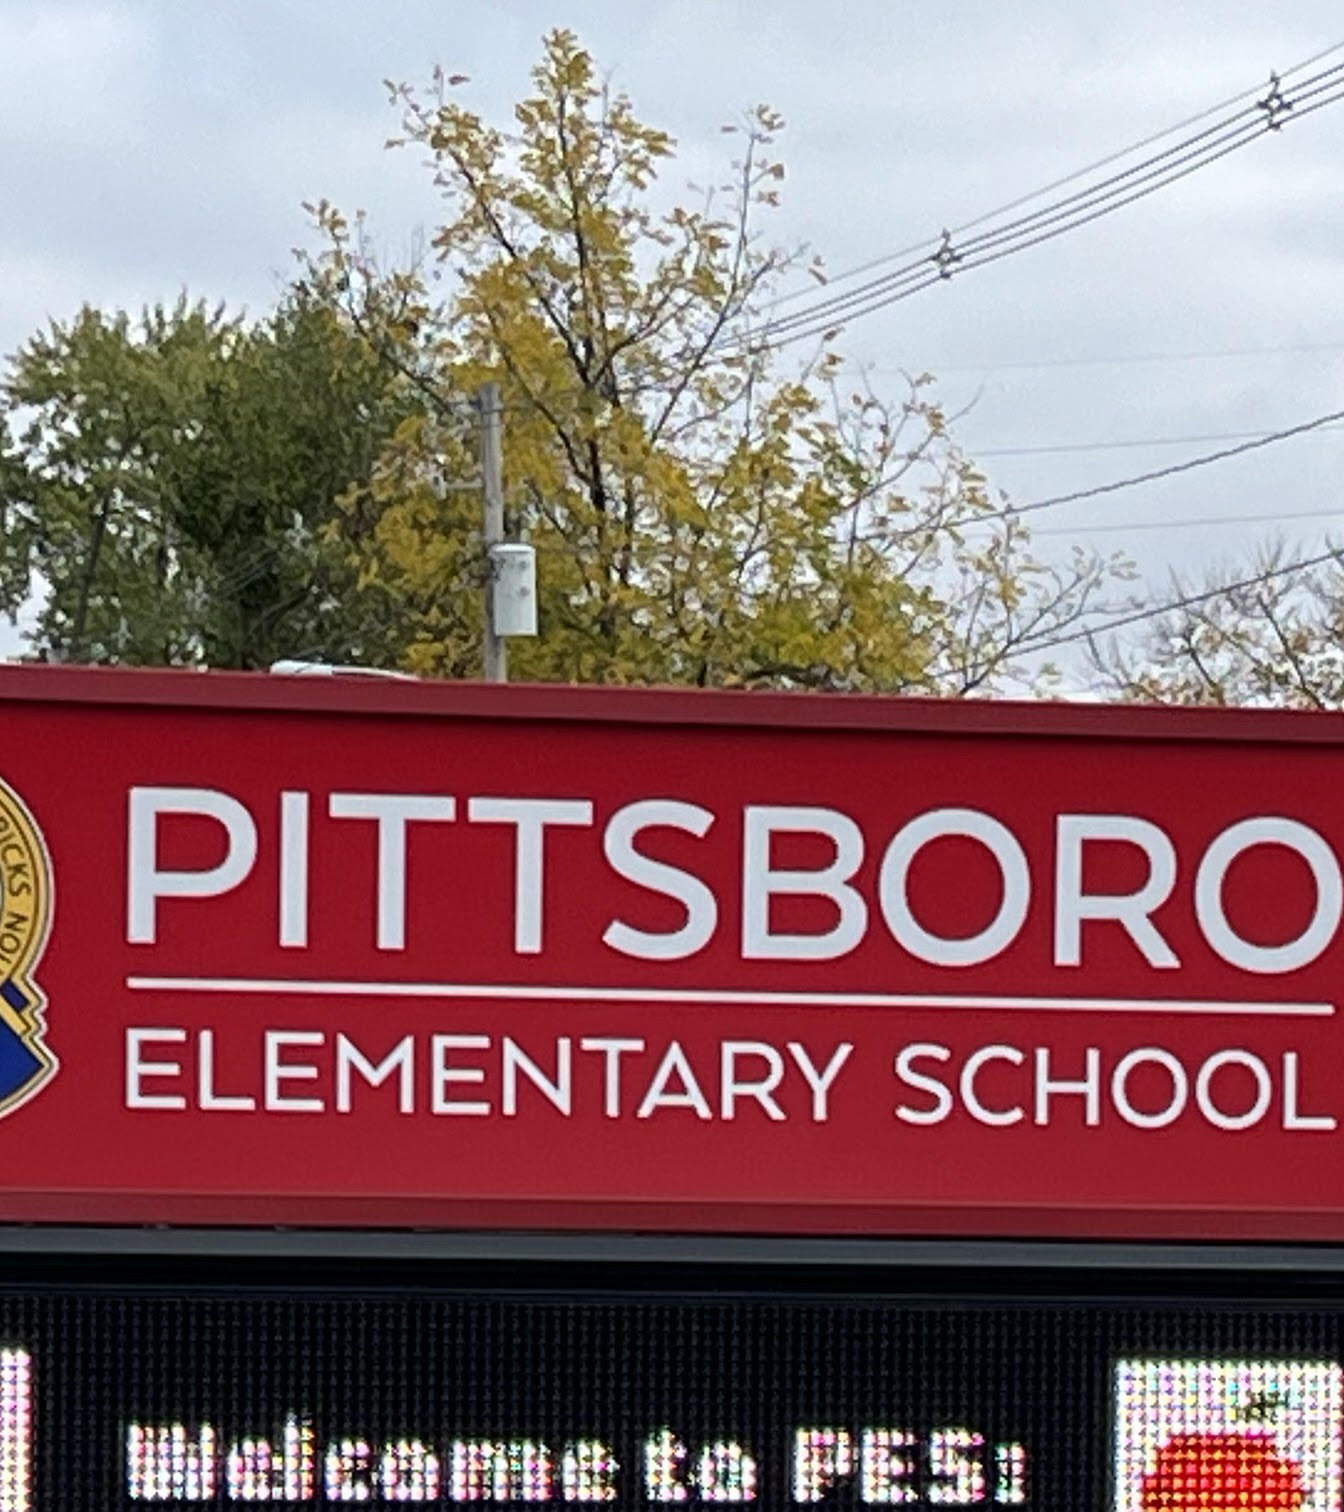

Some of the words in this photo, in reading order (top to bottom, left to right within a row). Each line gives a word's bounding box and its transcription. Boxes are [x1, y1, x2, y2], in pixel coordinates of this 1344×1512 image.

[128, 787, 1343, 974] PITTSBORO
[127, 1029, 853, 1120] ELEMENTARY
[896, 1044, 1335, 1129] SCHOOL
[127, 1414, 619, 1501] Welcome
[645, 1426, 756, 1502] to
[793, 1428, 1024, 1504] PES:
